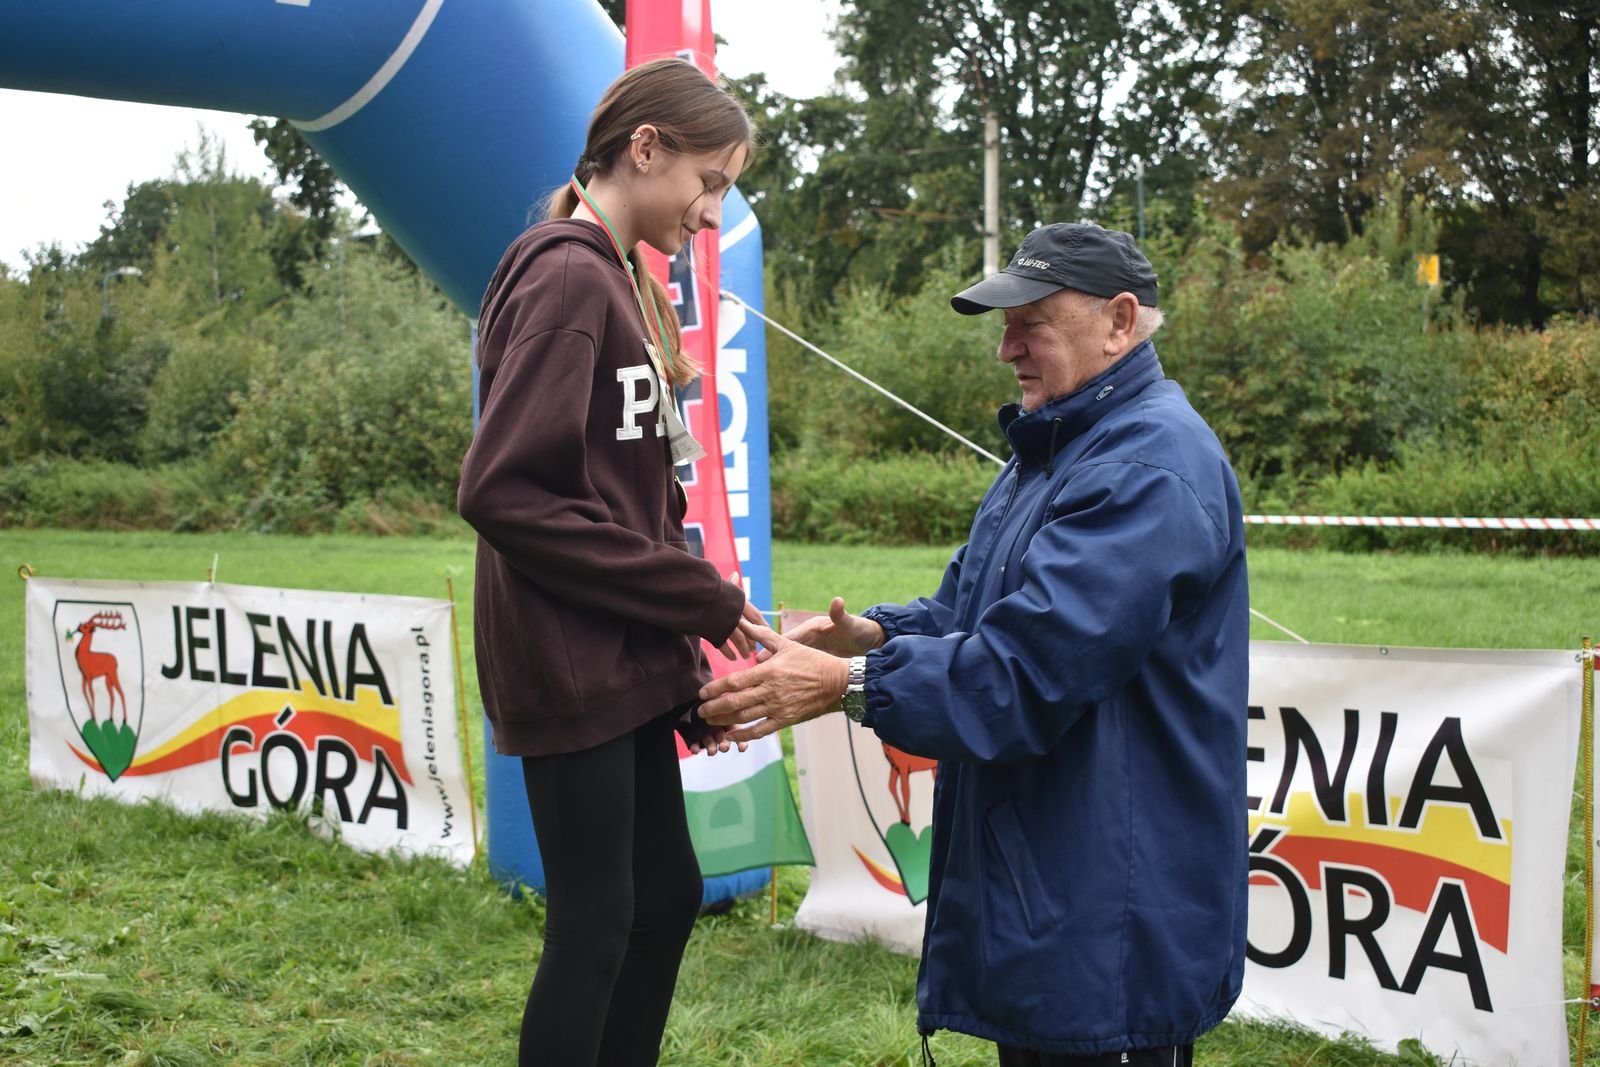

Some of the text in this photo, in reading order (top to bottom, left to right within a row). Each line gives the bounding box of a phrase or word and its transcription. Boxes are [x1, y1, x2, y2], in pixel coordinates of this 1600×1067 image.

[1023, 258, 1050, 270] HI-TEC
[616, 364, 666, 440] P
[161, 605, 395, 705] JELENIA
[221, 706, 408, 830] GÓRA
